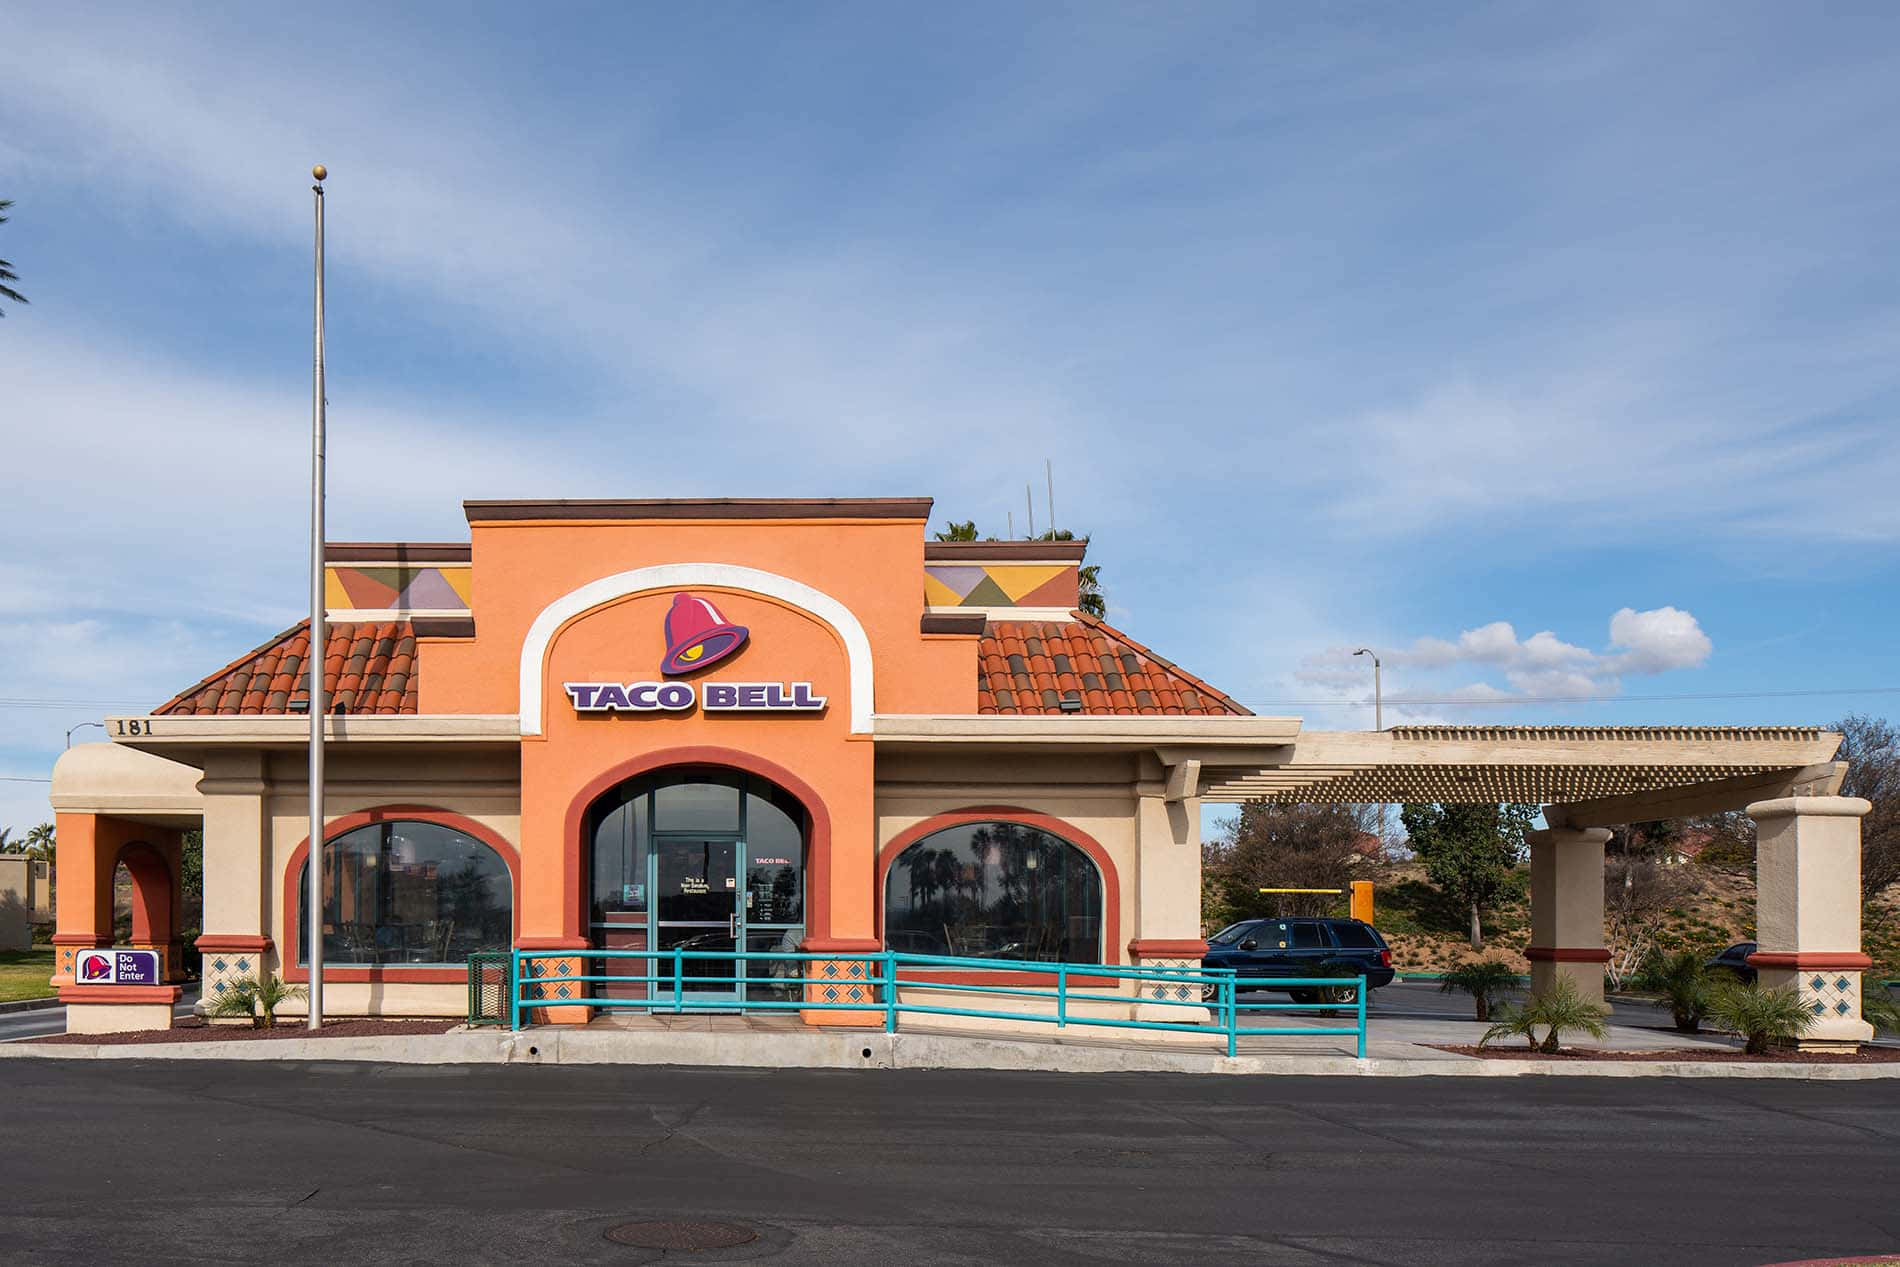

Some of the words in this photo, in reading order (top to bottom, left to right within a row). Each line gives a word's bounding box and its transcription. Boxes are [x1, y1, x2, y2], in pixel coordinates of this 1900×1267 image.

[568, 684, 693, 709] TACO
[704, 684, 824, 709] BELL
[117, 719, 153, 736] 181
[755, 857, 775, 865] TACO
[120, 954, 133, 962] Do
[120, 963, 137, 971] Not
[120, 972, 144, 980] Enter
